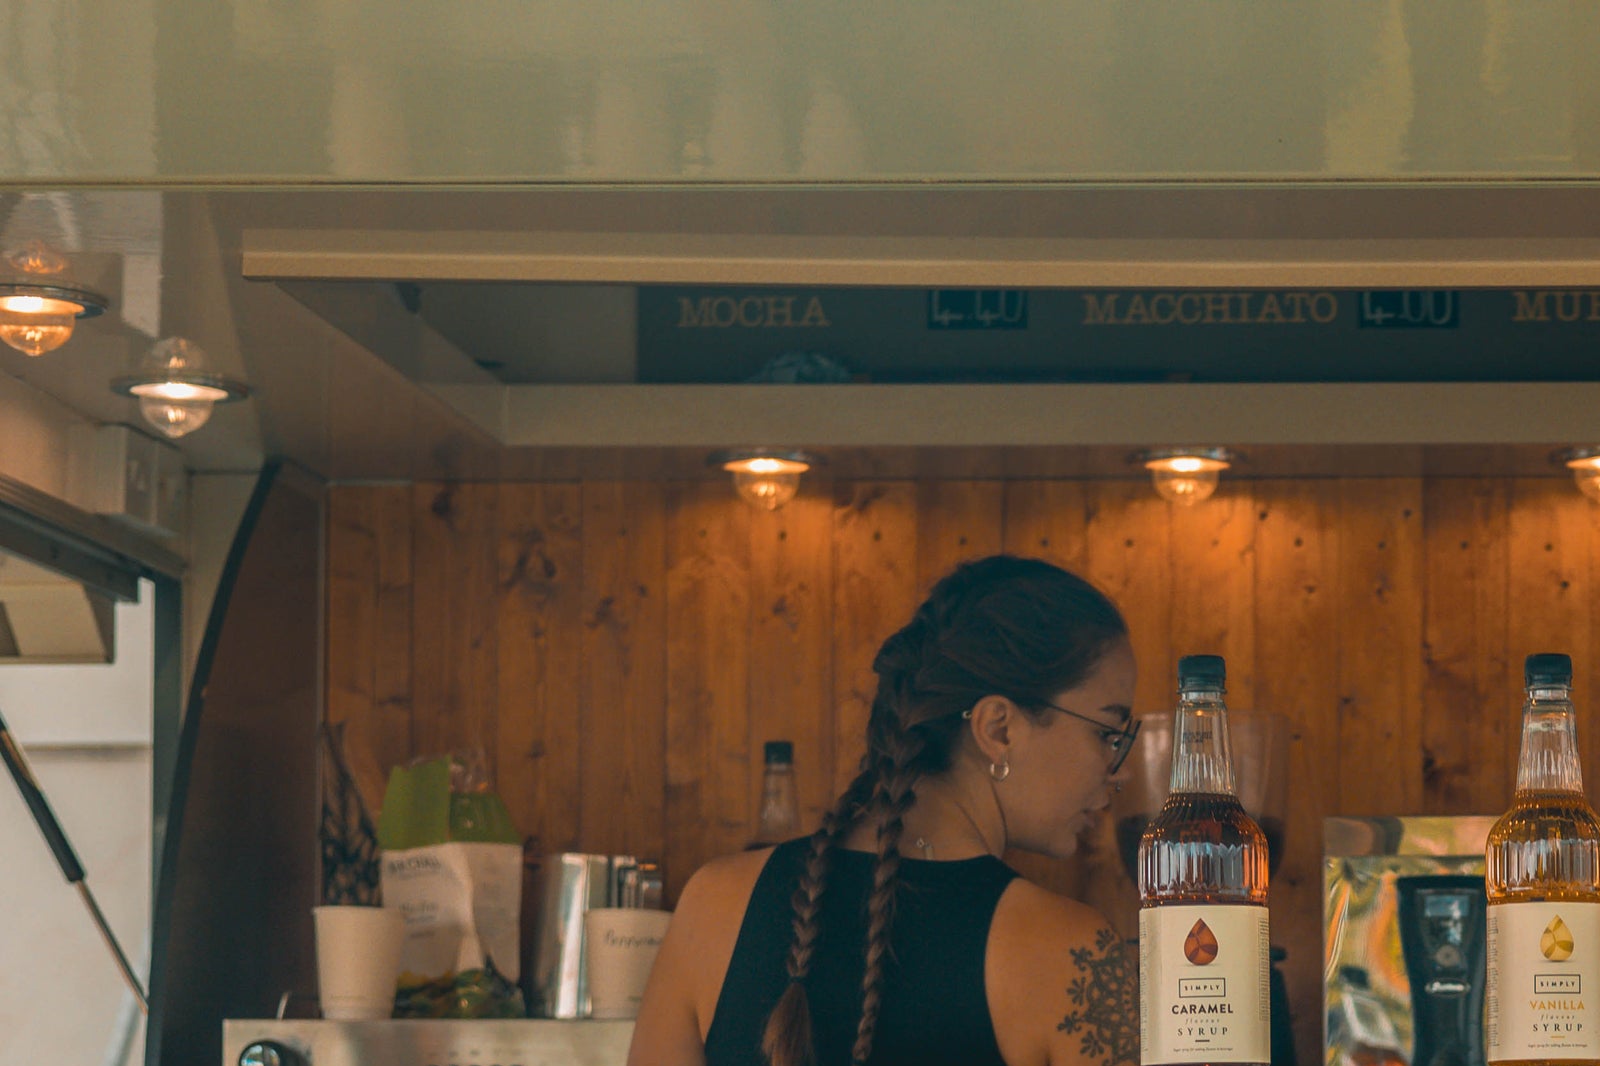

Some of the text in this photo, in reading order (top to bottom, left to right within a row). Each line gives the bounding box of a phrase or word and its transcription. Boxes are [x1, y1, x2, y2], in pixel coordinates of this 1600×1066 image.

[677, 296, 831, 328] MOCHA
[1081, 292, 1338, 325] MACCHIATO
[1184, 984, 1221, 992] SIMPLY
[1171, 1003, 1234, 1015] CARAMEL
[1529, 999, 1586, 1011] VANILLA
[1177, 1026, 1229, 1037] SYRUP
[1532, 1023, 1583, 1033] SYRUP
